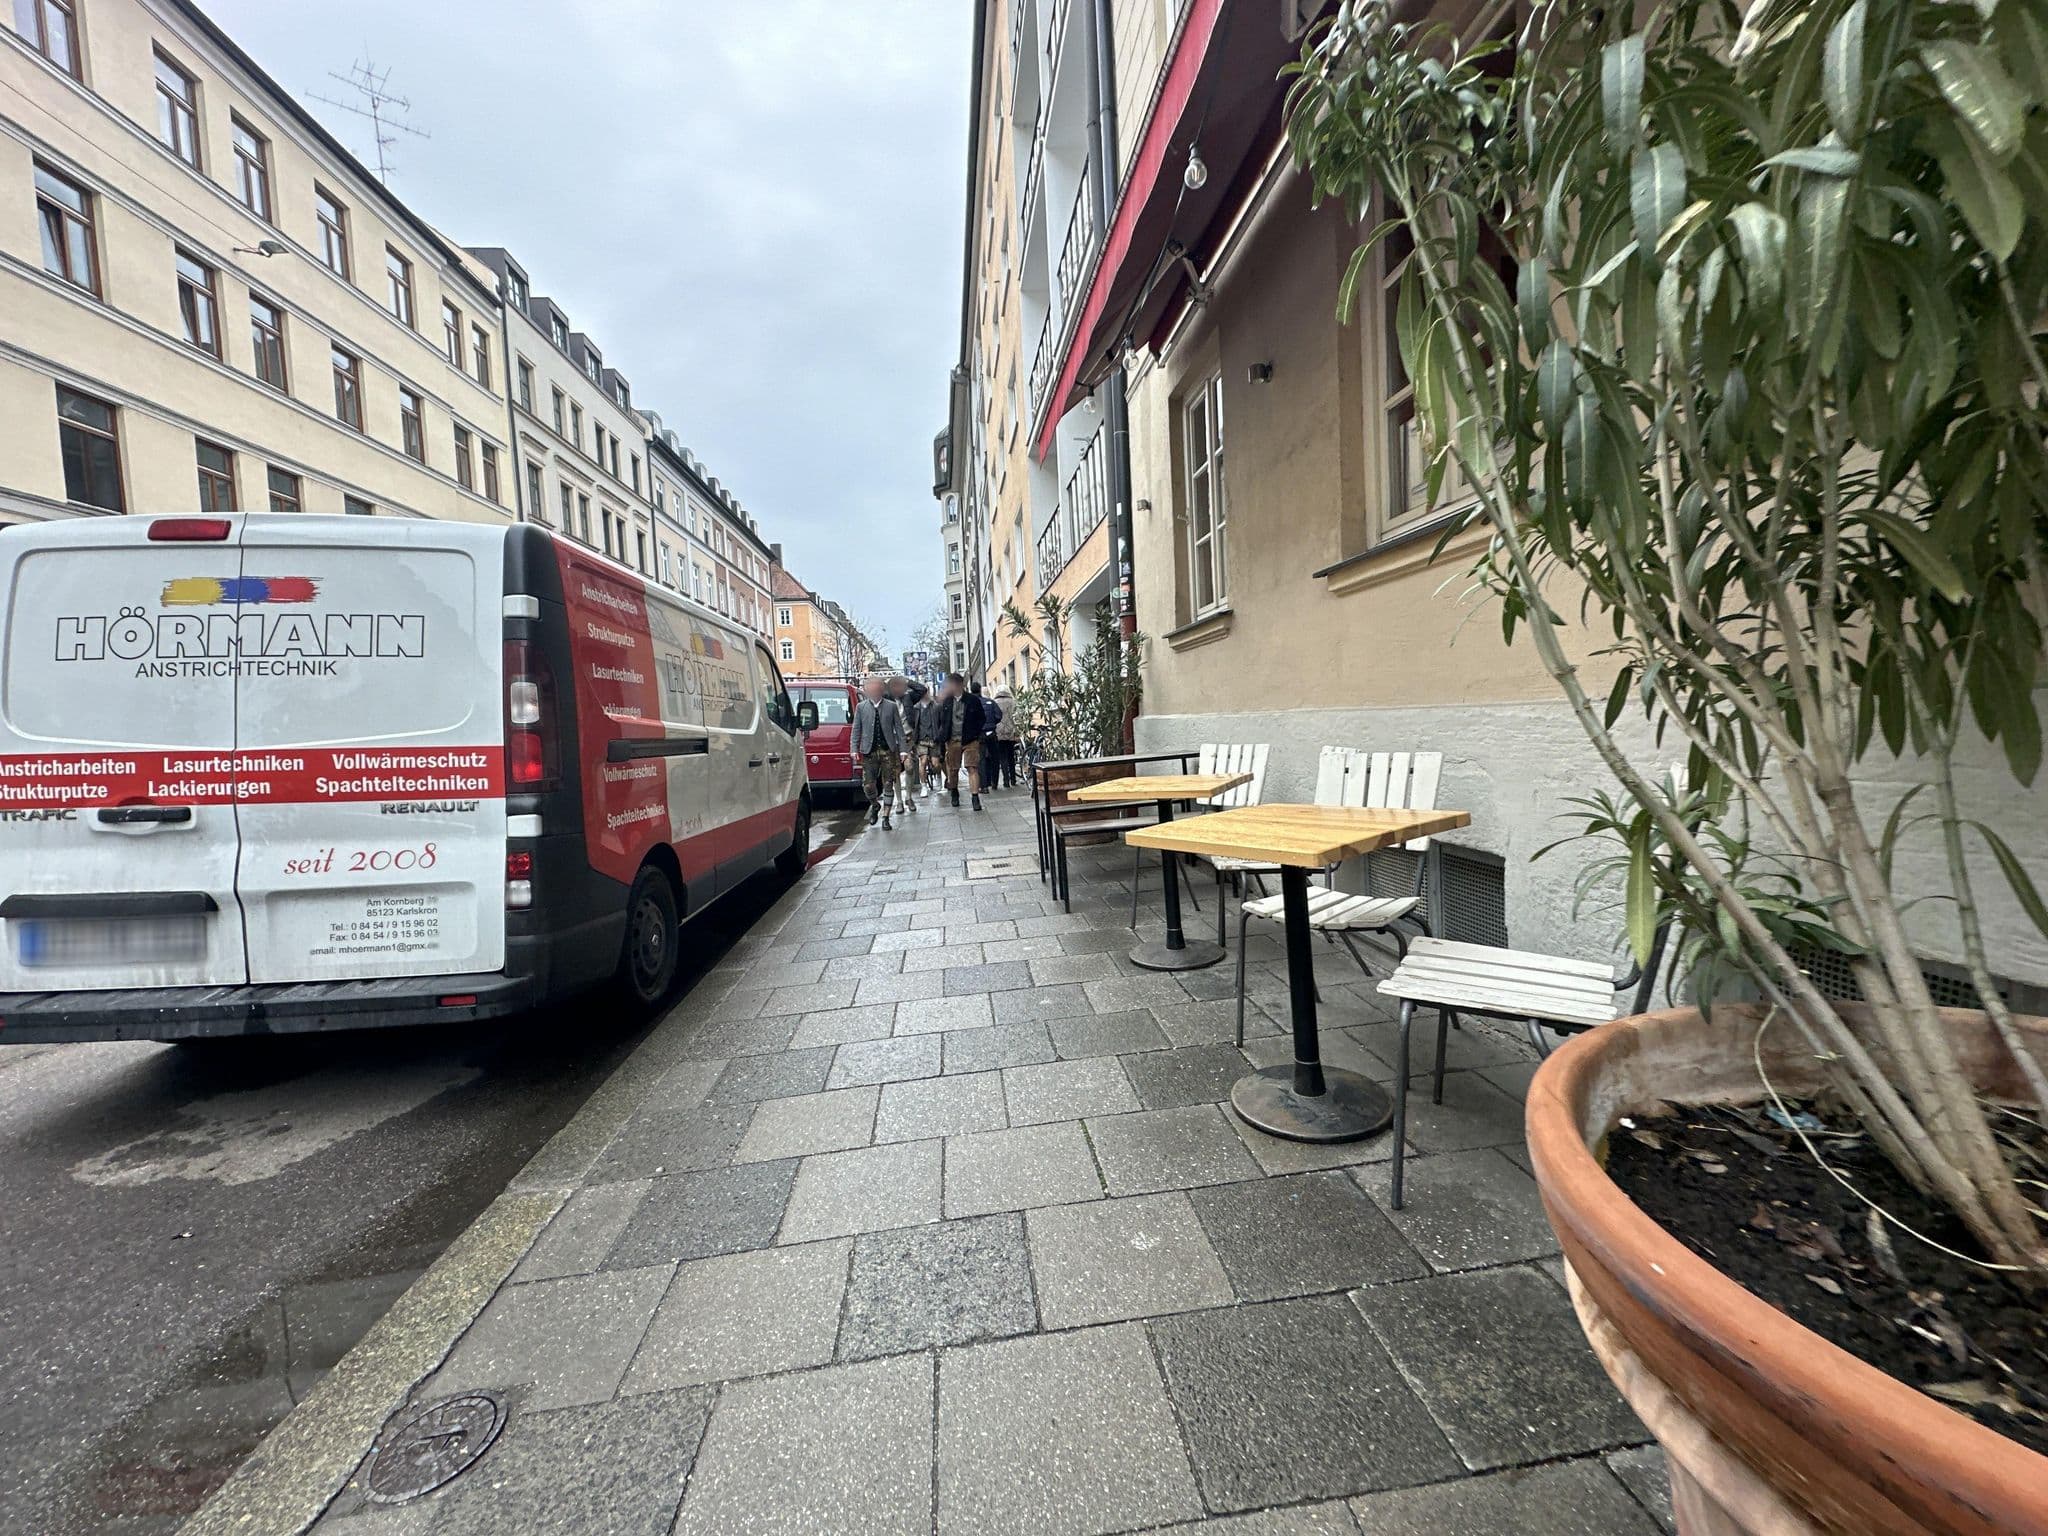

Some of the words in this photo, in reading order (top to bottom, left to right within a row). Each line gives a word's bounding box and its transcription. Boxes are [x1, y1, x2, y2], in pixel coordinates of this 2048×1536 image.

[56, 606, 425, 661] HÖRMANN
[135, 660, 337, 678] ANSTRICHTECHNIK
[592, 662, 644, 685] Lasurtechniken
[163, 755, 304, 774] Lasurtechniken
[332, 752, 487, 770] Vollwärmeschutz
[603, 764, 657, 782] Vollwärmeschutz
[148, 780, 271, 799] Lackierungen
[315, 775, 489, 796] Spachteltechniken
[0, 809, 77, 822] TRAFIC
[380, 800, 480, 814] RENAULT
[284, 848, 335, 875] seit
[348, 842, 437, 872] 2008
[366, 899, 381, 907] Am
[367, 908, 393, 917] 85123
[396, 907, 438, 916] Karlskron
[373, 921, 384, 929] 54
[427, 919, 438, 927] 02
[339, 942, 439, 954] mhoermann1@gmx.
